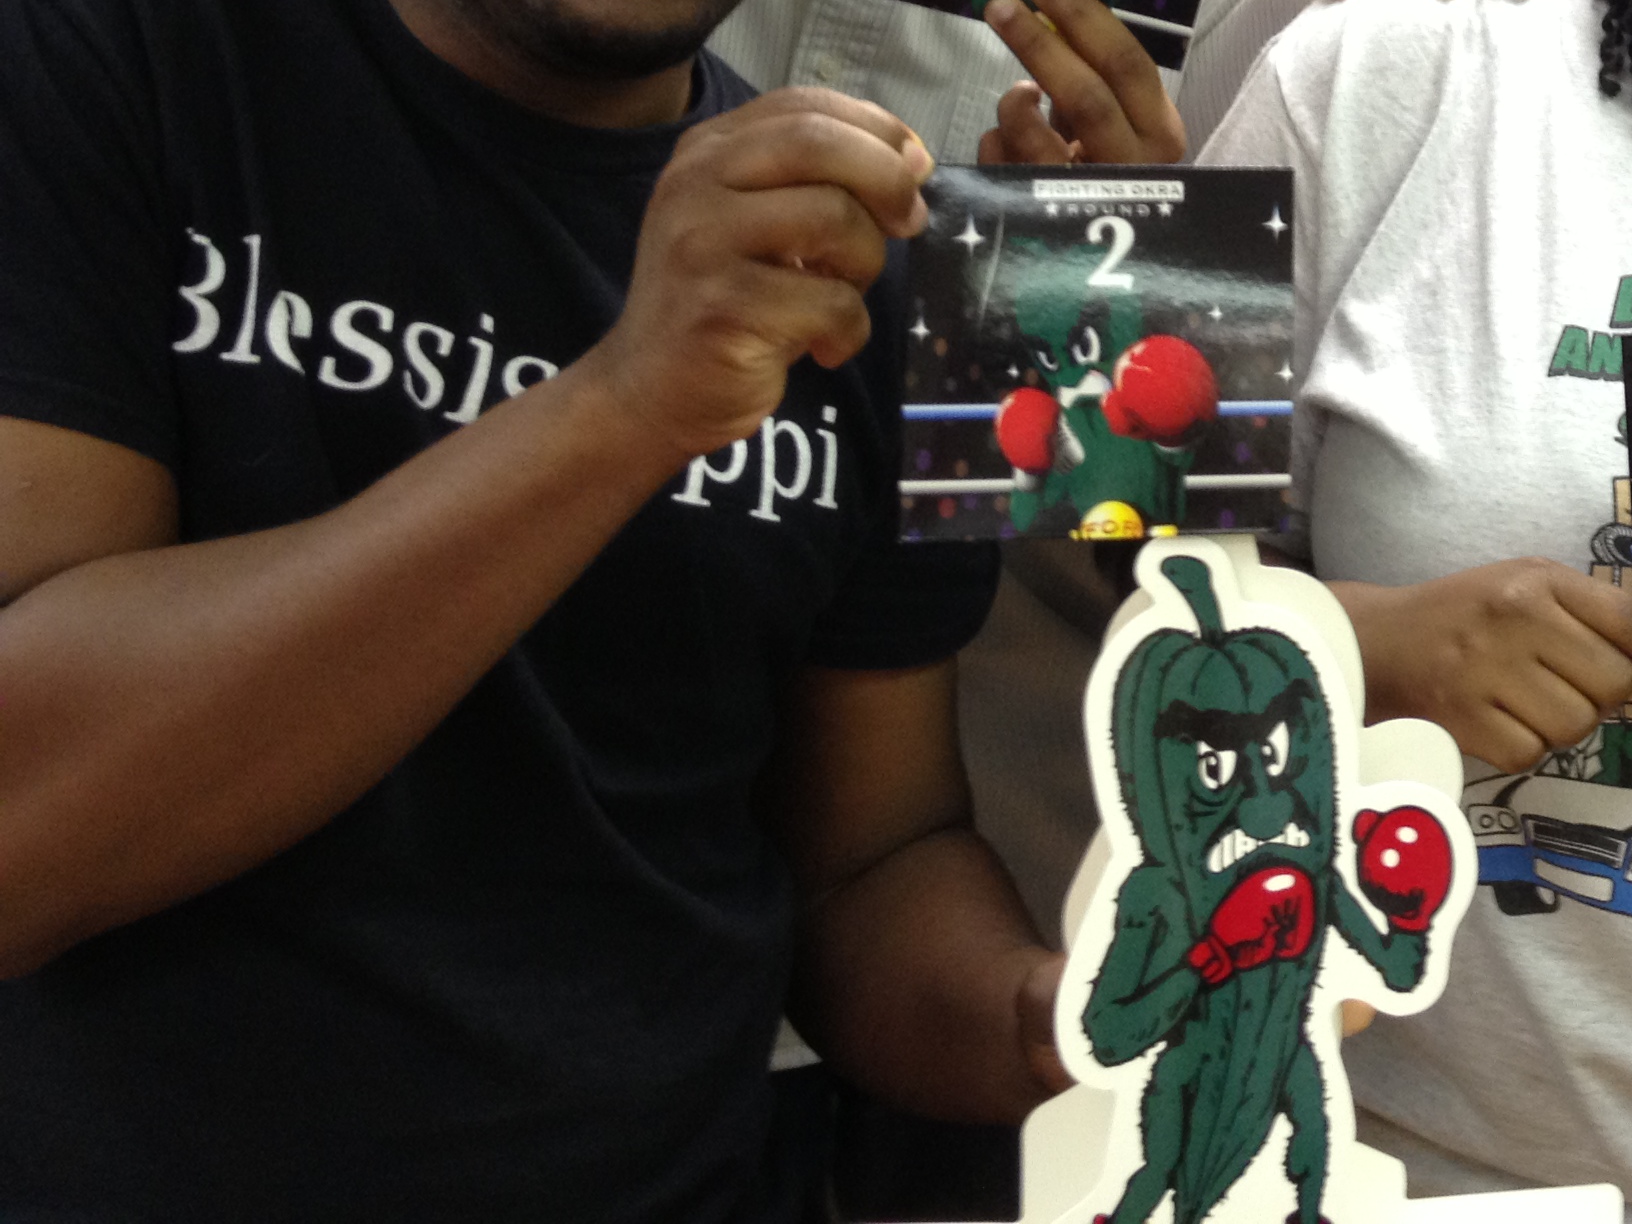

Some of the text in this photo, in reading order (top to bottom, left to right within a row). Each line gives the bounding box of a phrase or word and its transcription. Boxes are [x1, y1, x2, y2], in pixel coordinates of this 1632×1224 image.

[1037, 182, 1181, 196] FIGHTING OKRA
[1066, 203, 1151, 216] ROUND
[1086, 215, 1135, 290] 2
